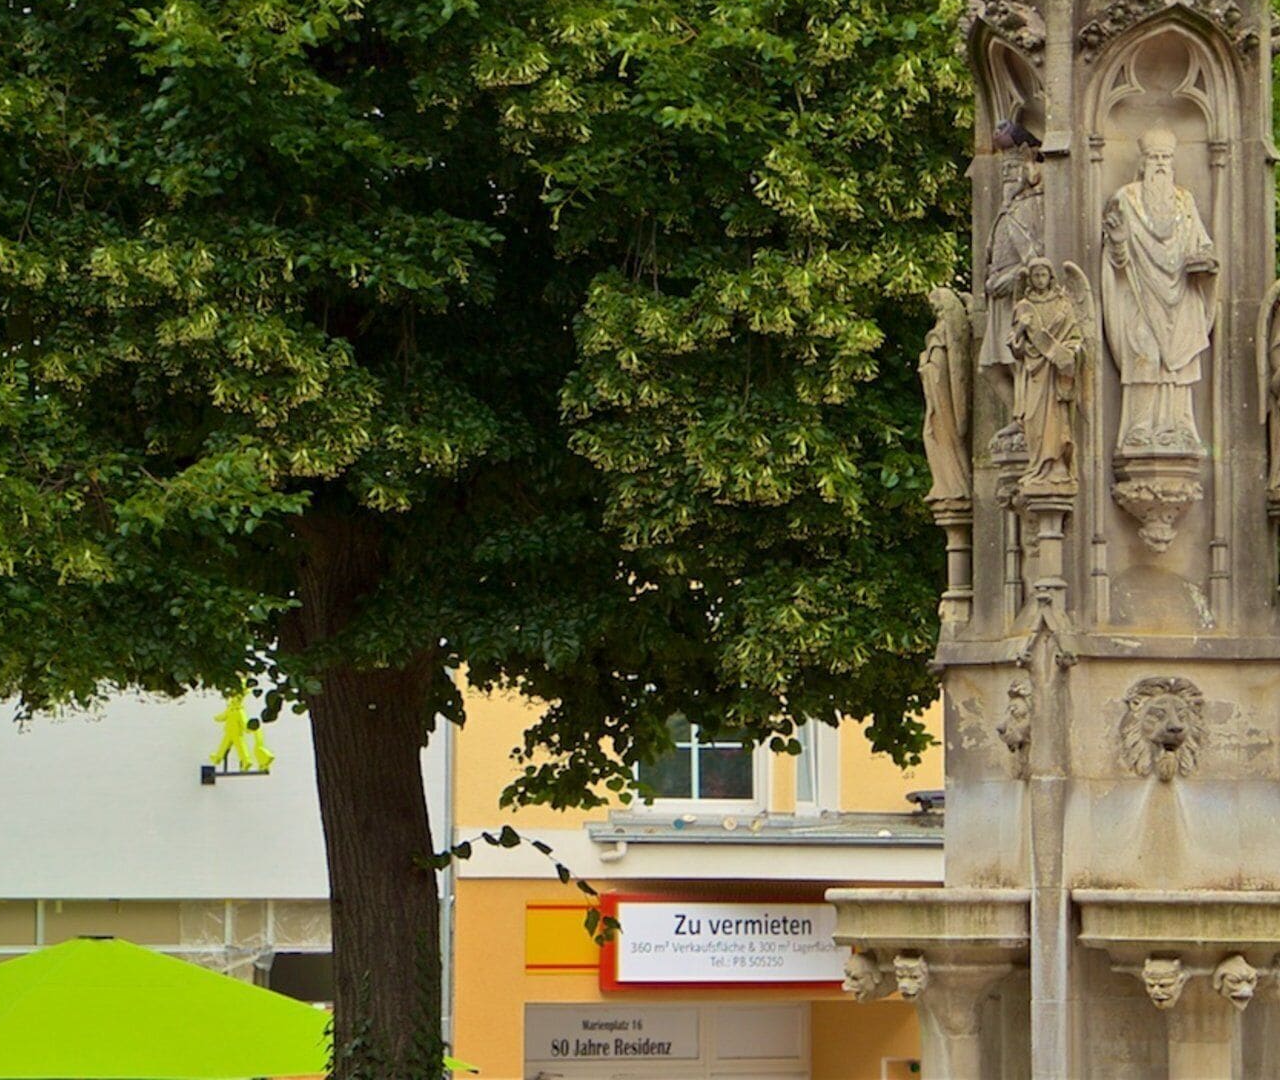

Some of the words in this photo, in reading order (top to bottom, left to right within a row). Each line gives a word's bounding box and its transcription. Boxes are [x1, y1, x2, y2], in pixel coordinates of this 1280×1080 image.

[674, 914, 701, 936] Zu
[708, 913, 812, 936] vermieten
[672, 941, 745, 953] Verkaufsfläche
[582, 1020, 629, 1032] Marienplatz
[551, 1039, 569, 1057] 80
[574, 1038, 610, 1057] Jahre
[614, 1037, 672, 1056] Residenz
